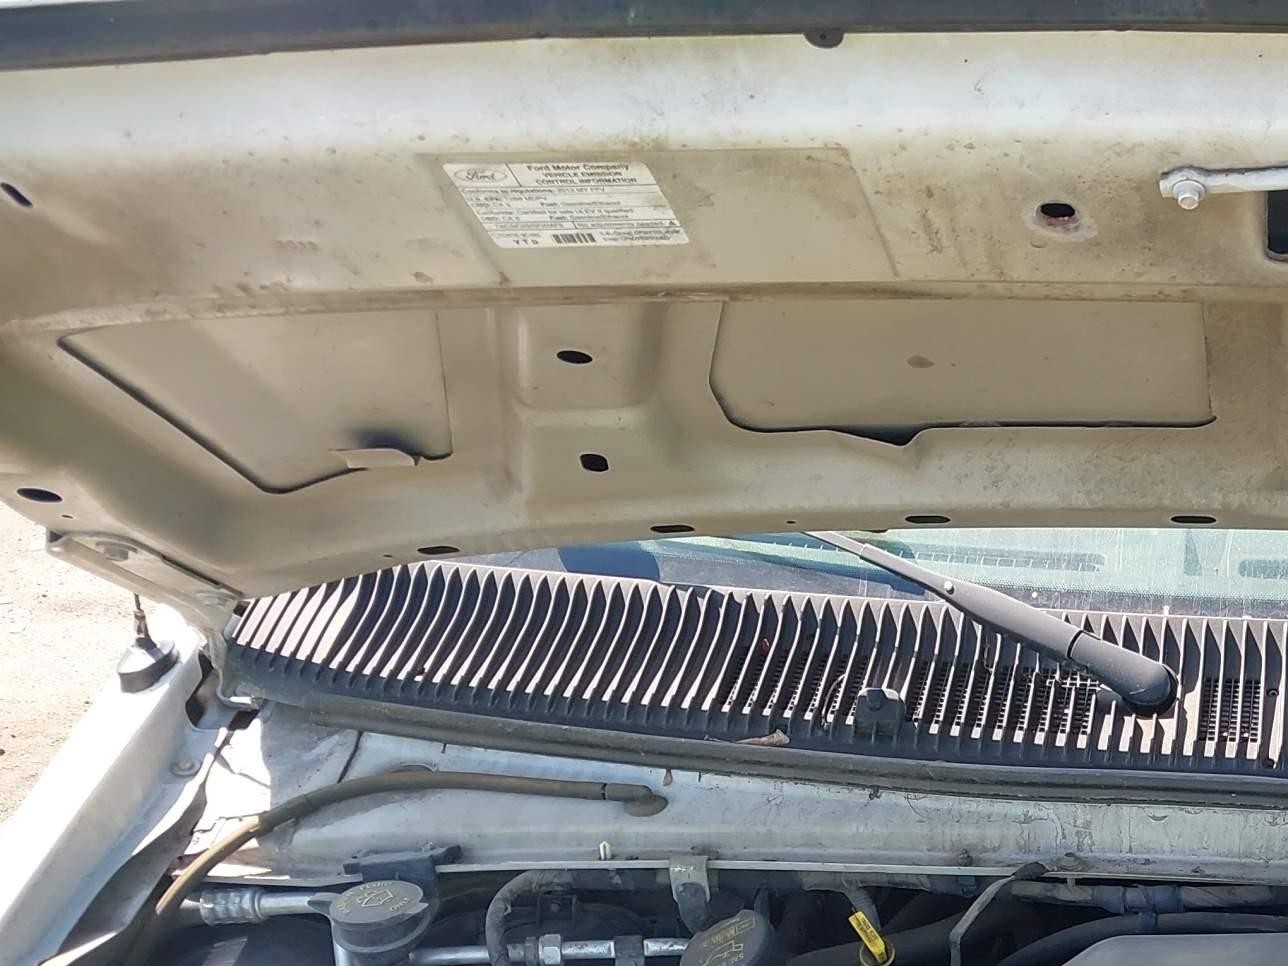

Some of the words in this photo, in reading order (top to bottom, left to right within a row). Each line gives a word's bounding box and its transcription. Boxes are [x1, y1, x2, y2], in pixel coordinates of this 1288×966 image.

[527, 164, 550, 172] Ford
[551, 164, 580, 172] Motor
[582, 163, 630, 172] Company
